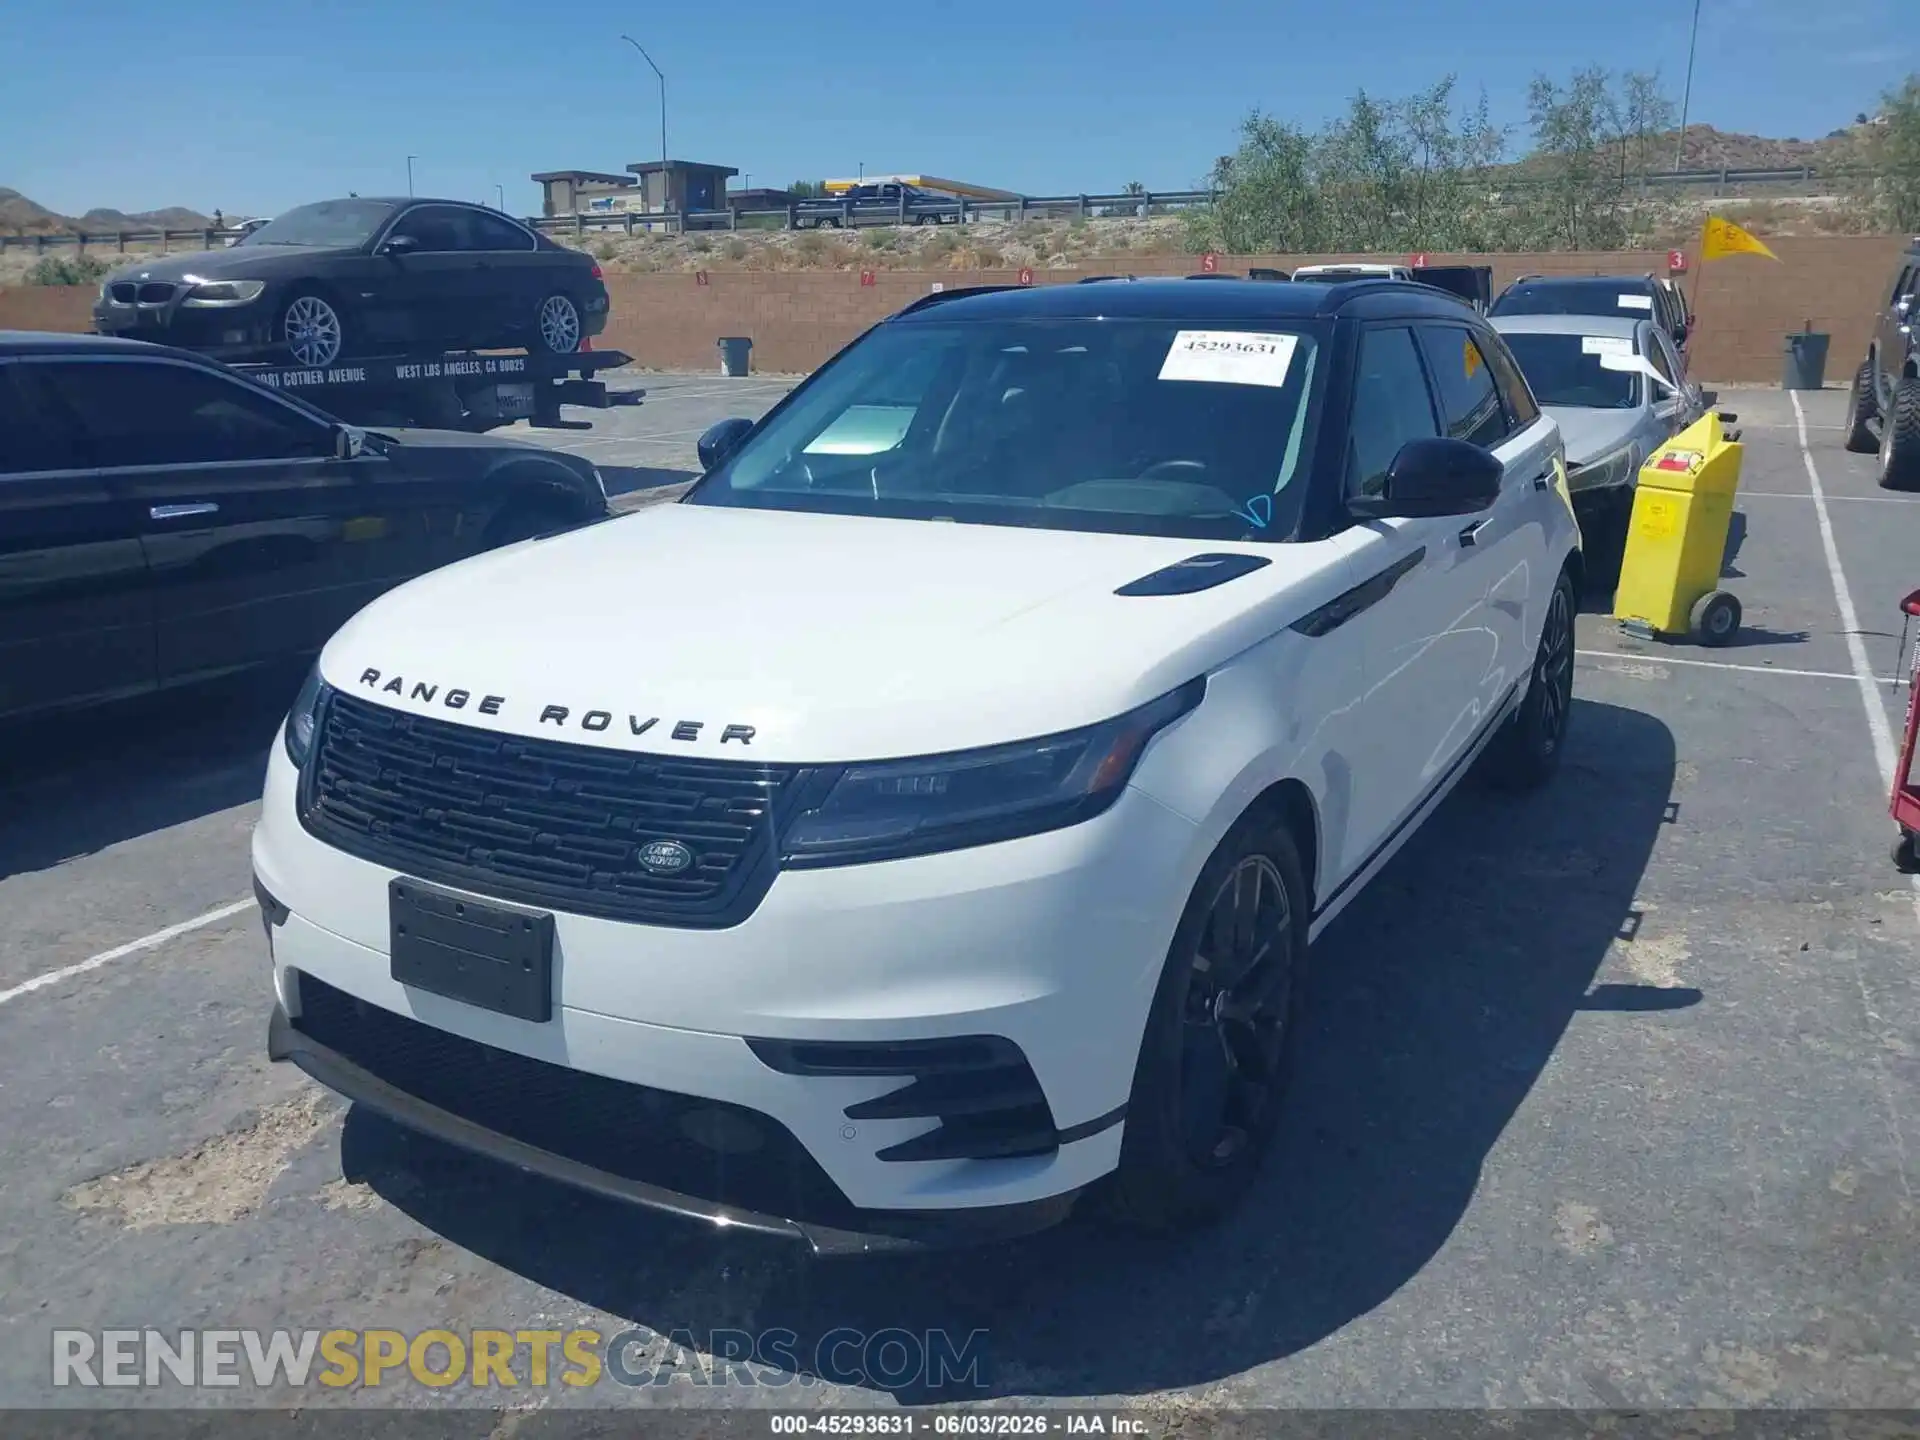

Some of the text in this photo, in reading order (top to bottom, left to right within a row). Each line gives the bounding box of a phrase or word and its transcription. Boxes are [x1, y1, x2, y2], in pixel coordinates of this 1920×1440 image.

[1671, 252, 1682, 268] 3
[1184, 341, 1276, 355] 45293631
[283, 370, 324, 386] COTNER
[328, 367, 366, 383] AVENUE
[396, 359, 525, 379] WEST LOS ANGELES, CA 90025
[359, 667, 757, 745] RANGE ROVER
[647, 846, 675, 856] LAND
[648, 855, 681, 867] ROVER
